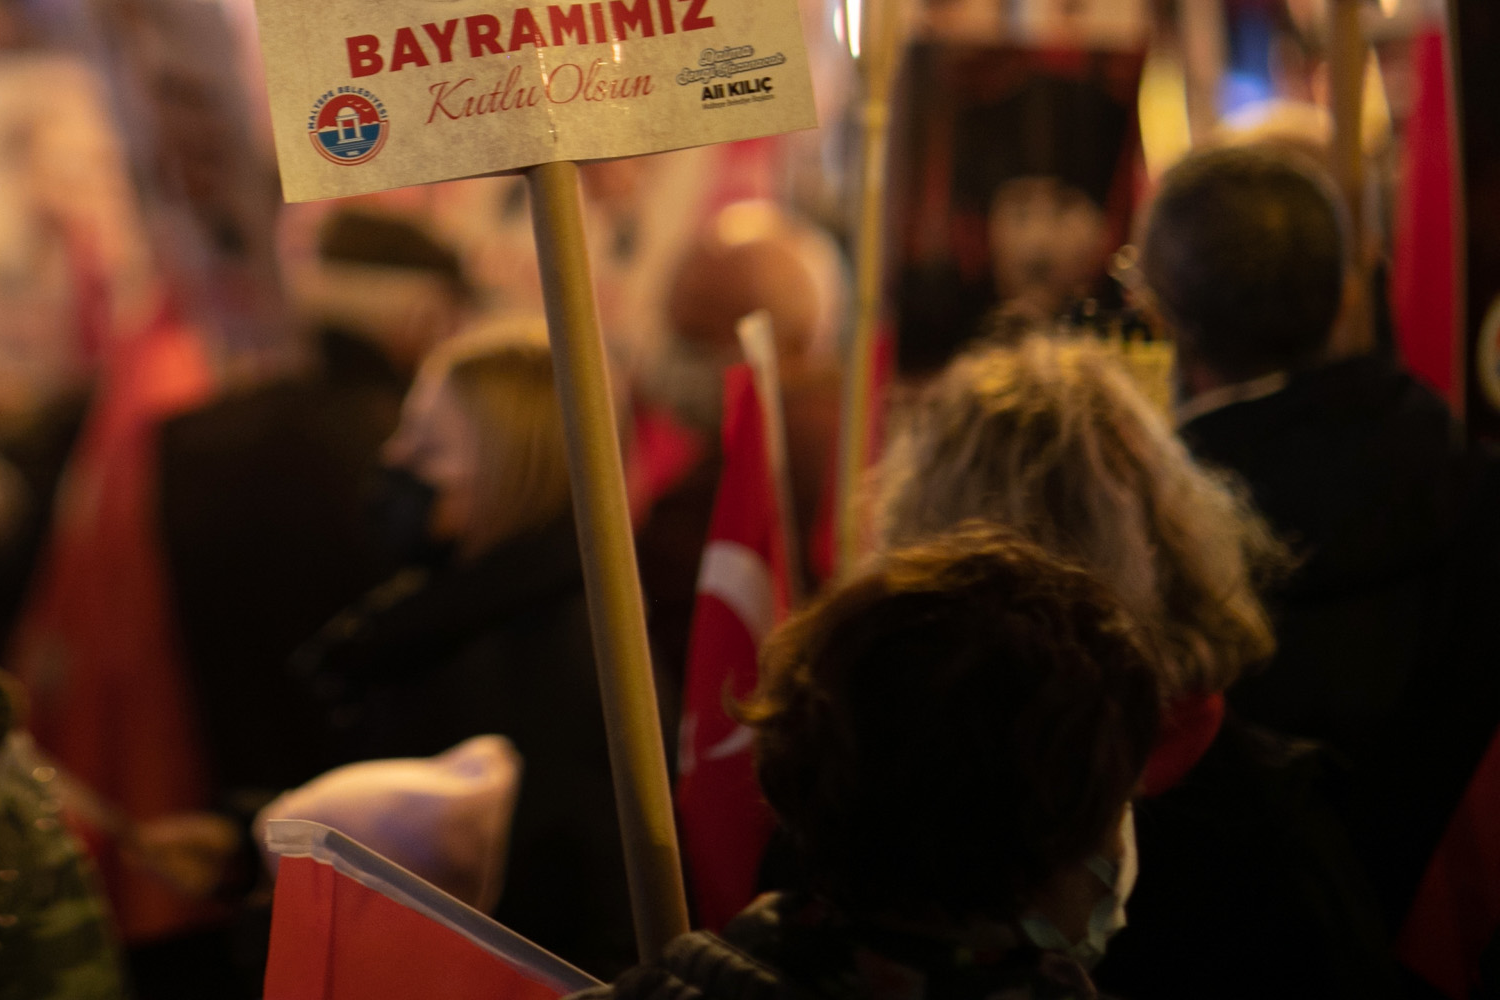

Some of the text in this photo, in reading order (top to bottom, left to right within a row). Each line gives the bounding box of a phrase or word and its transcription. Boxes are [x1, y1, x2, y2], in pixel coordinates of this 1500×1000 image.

[698, 44, 756, 67] Daima
[427, 60, 654, 125] Kutlu Olsun
[701, 77, 774, 101] Ali KILIÇ
